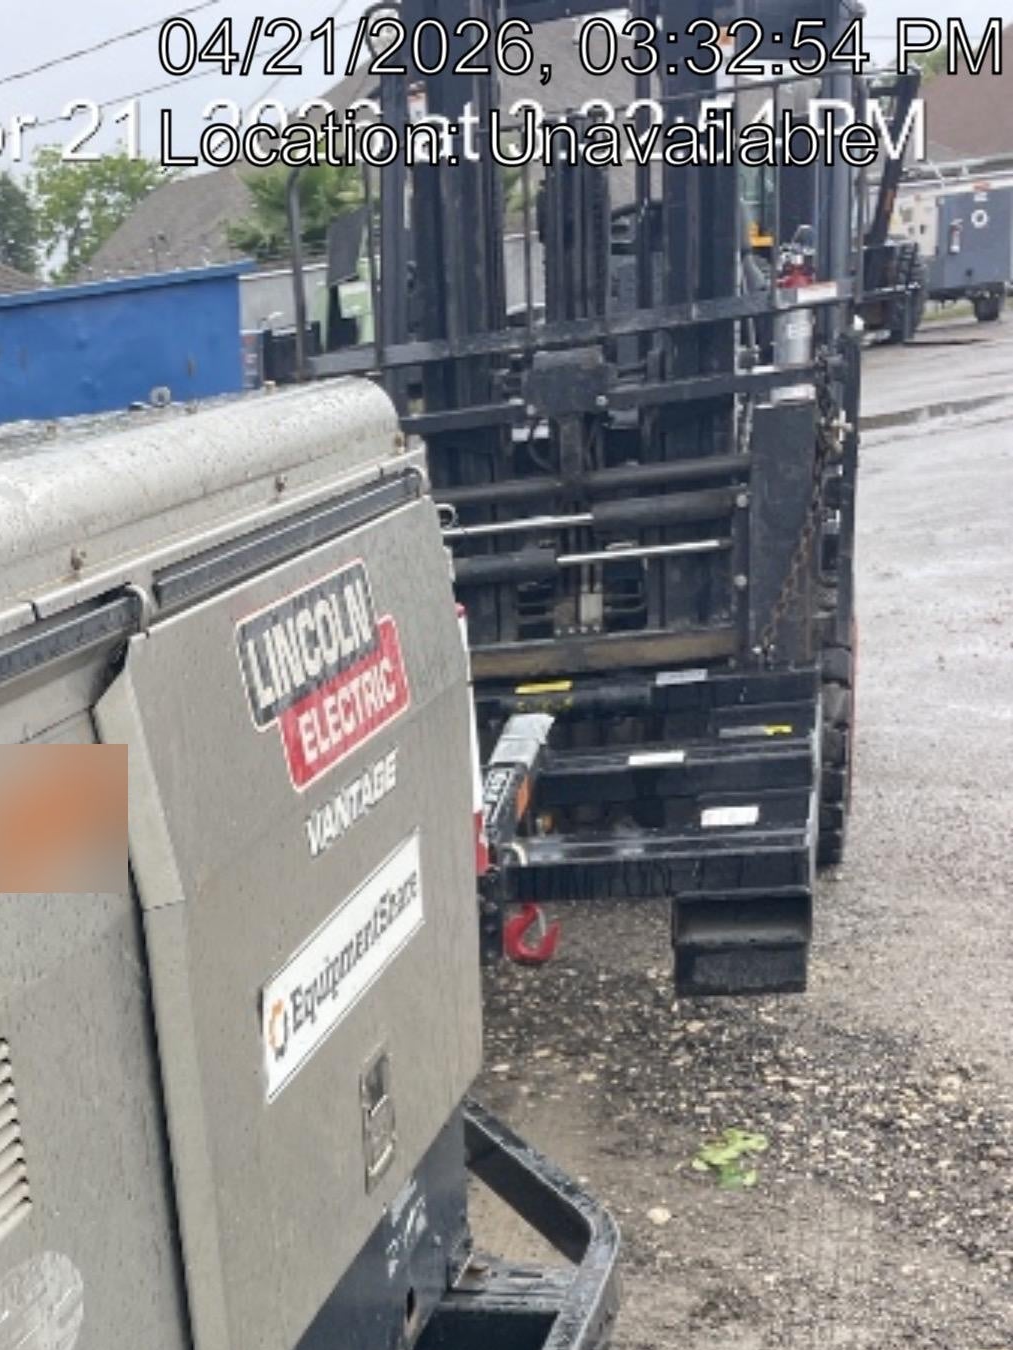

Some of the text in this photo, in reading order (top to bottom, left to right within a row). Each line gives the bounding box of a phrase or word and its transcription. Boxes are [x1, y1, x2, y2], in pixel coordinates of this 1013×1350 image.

[247, 578, 372, 709] LINCOLN
[297, 656, 397, 765] ELECTRIC
[304, 745, 400, 858] VANTAGE
[289, 872, 418, 1035] EquipmentShare
